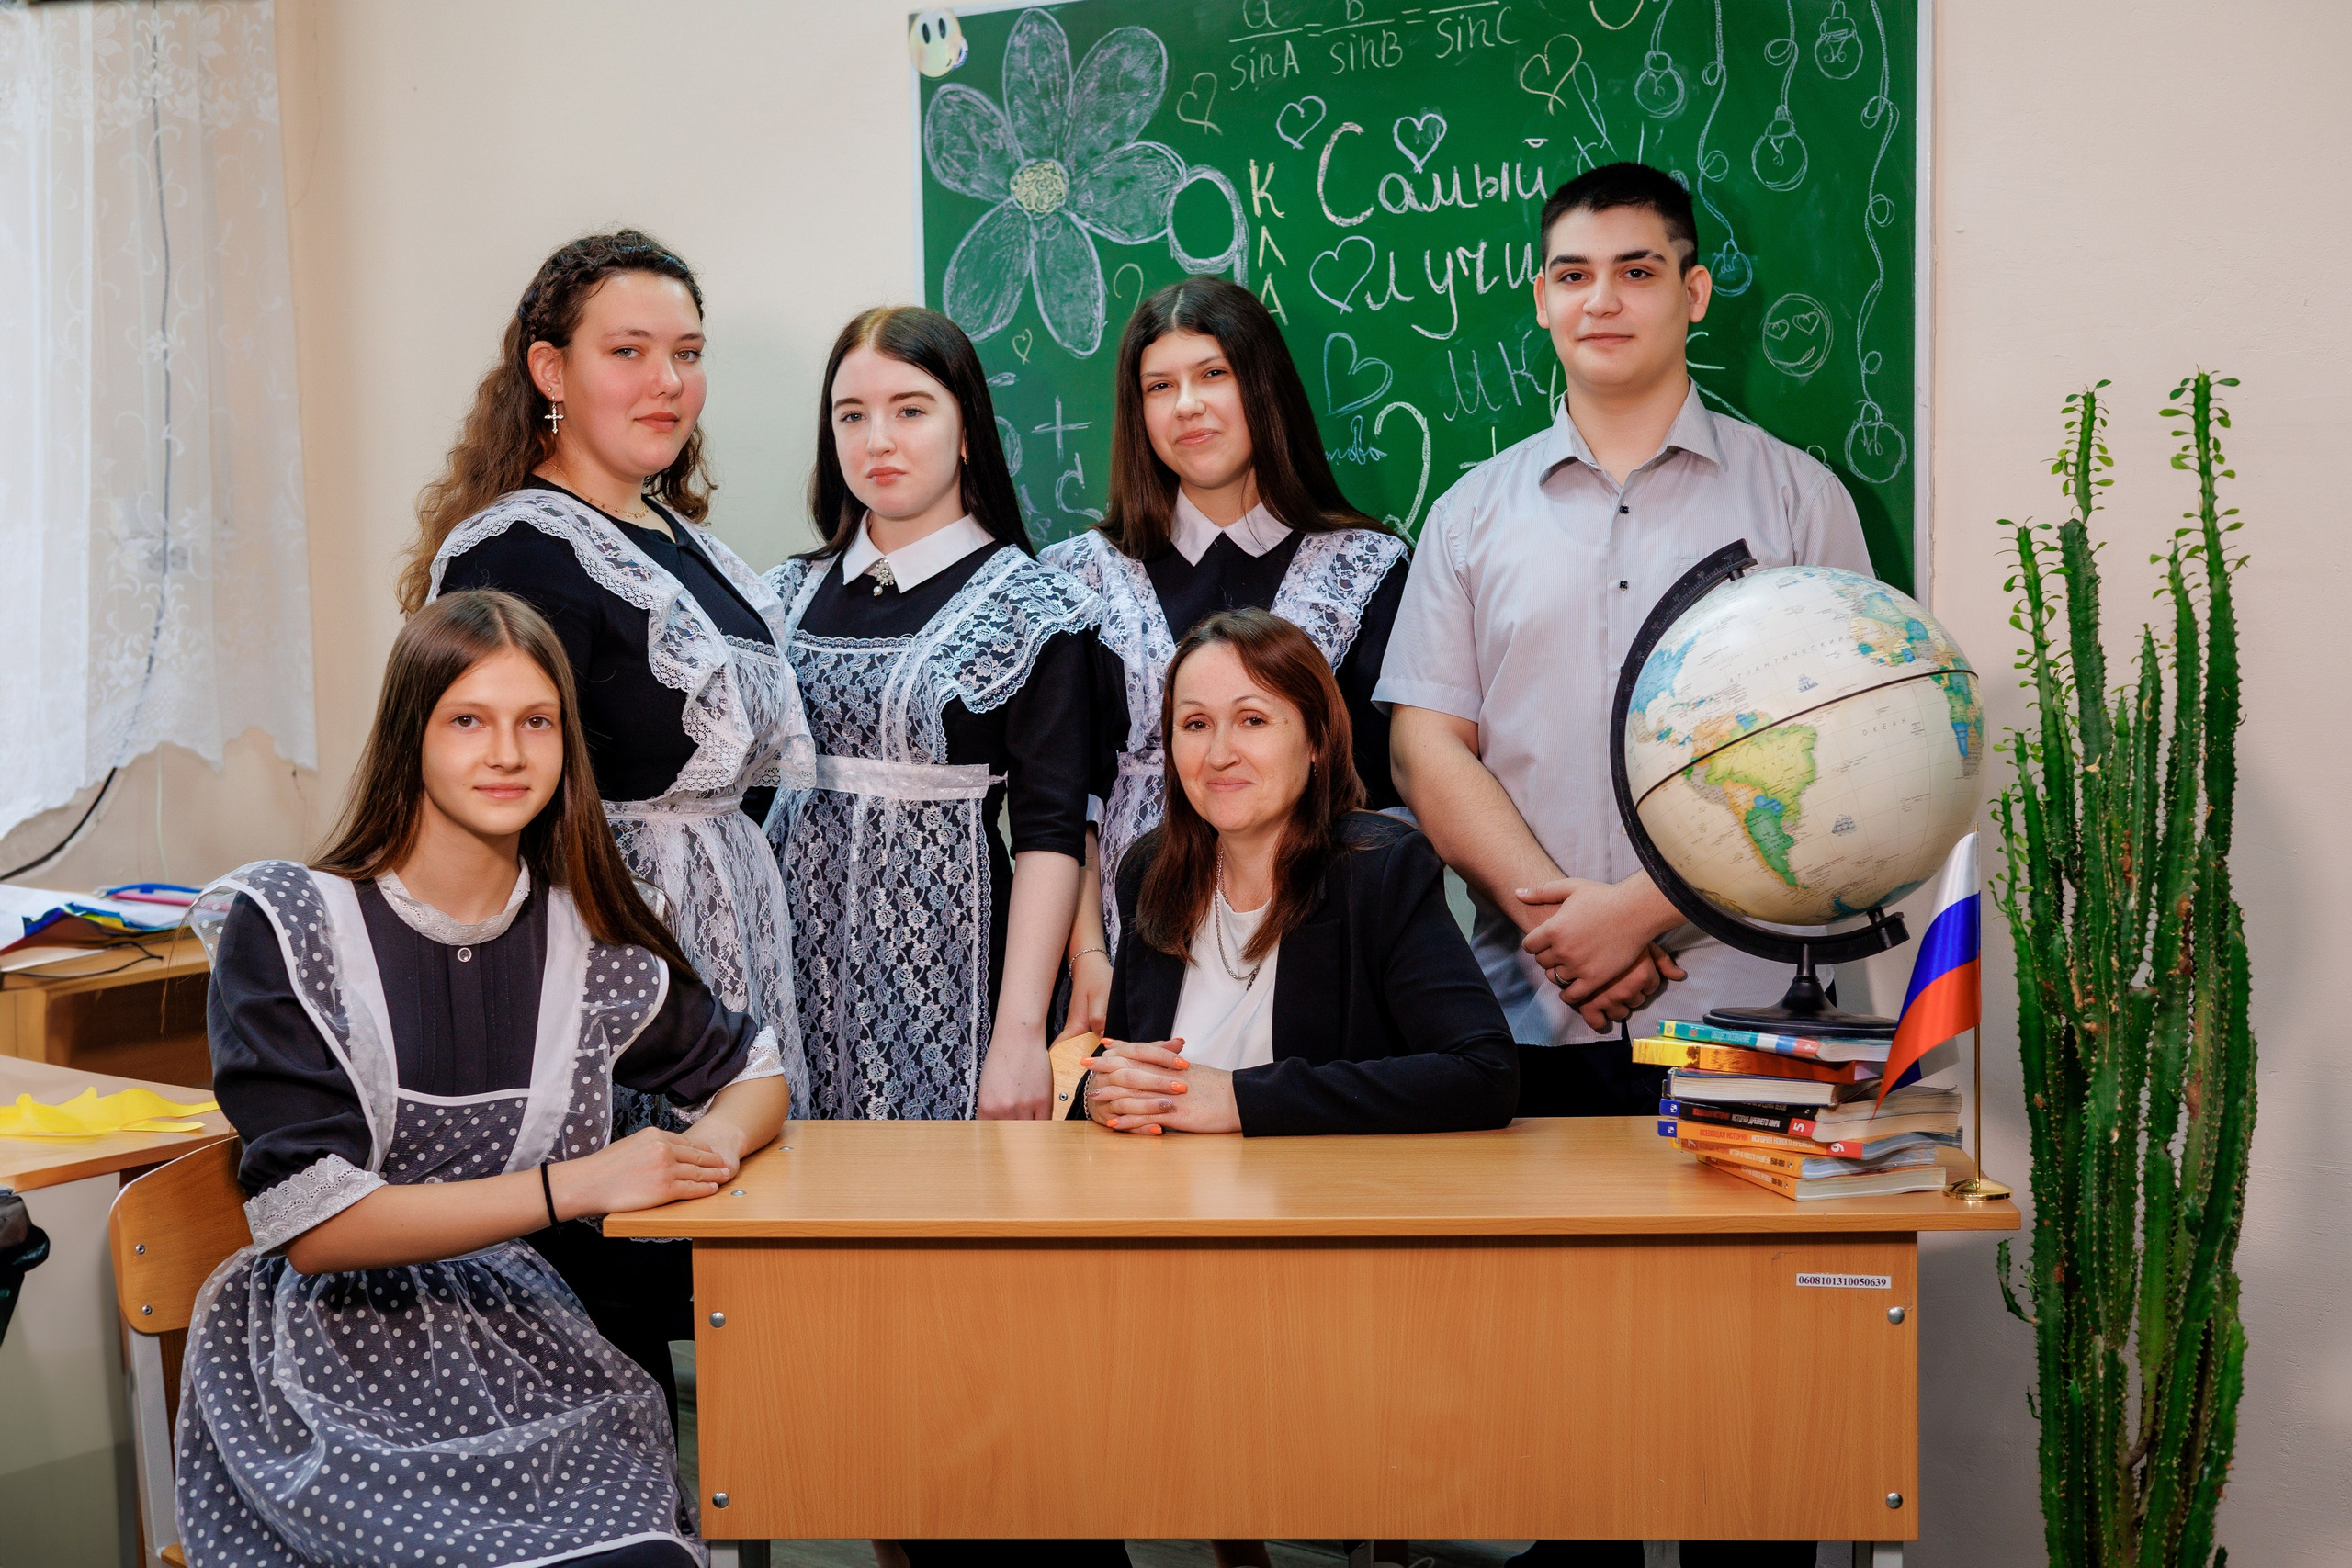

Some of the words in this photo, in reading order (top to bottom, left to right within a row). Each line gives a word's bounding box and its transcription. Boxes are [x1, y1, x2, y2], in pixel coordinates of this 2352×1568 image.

[1317, 121, 1549, 228] Самый
[1861, 716, 1907, 737] ОКЕАН
[1792, 1122, 1804, 1134] 5
[1699, 1129, 1726, 1140] ВСЕОБЩАЯ
[1726, 1132, 1748, 1142] ИСТОРИЯ
[1750, 1135, 1773, 1145] ИСТОРИЯ
[1773, 1137, 1792, 1147] НОВОГО
[1798, 1275, 1886, 1287] 0608101310050639
